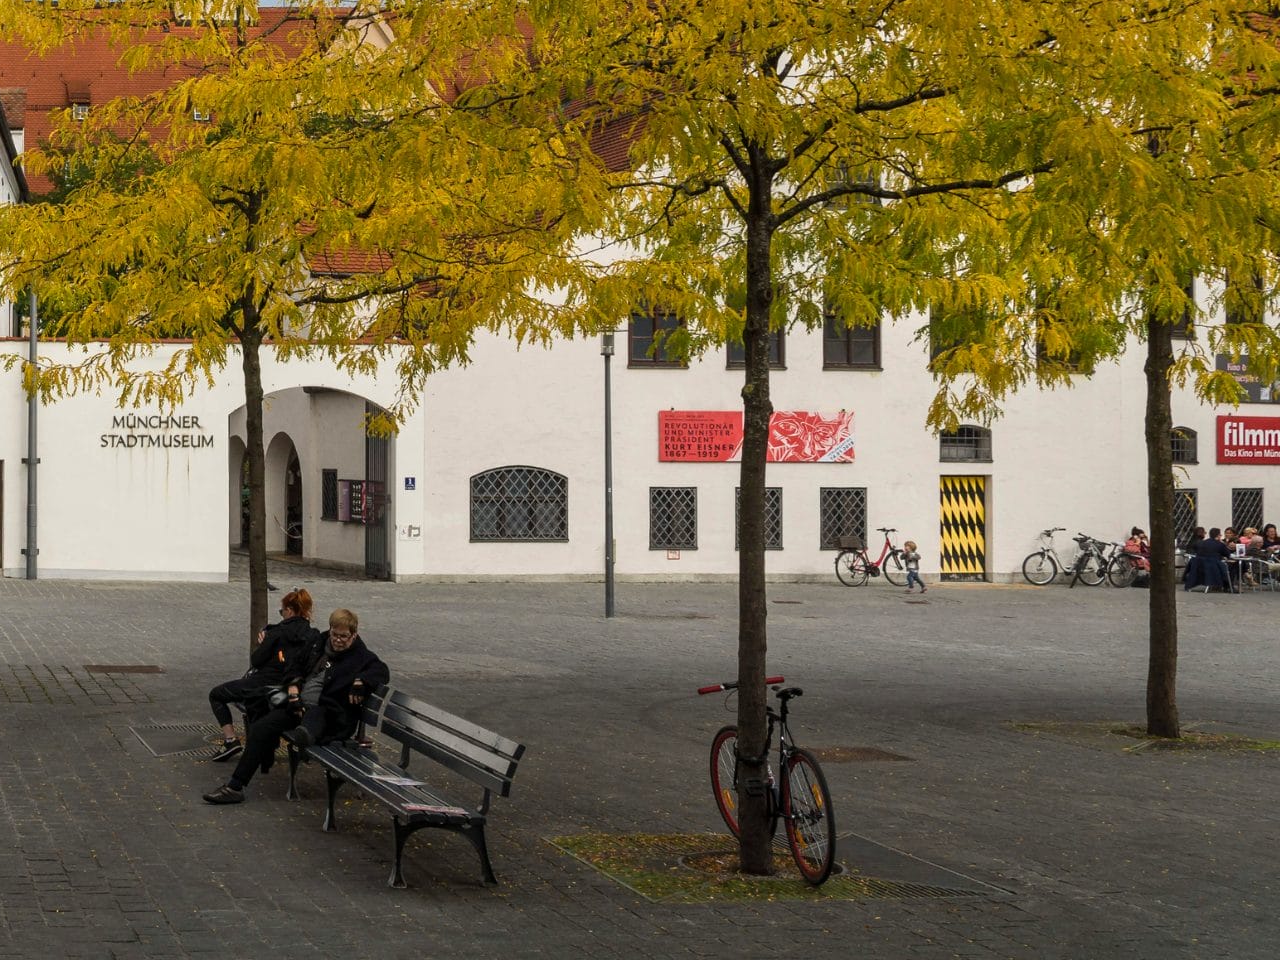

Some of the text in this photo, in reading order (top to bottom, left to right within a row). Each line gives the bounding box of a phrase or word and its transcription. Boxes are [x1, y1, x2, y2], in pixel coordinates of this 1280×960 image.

[112, 413, 201, 429] MÜNCHNER
[100, 434, 214, 448] STADTMUSEUM
[664, 443, 735, 451] KURT EISNER
[1224, 448, 1237, 457] Das
[1237, 448, 1253, 457] Kino
[1254, 448, 1263, 457] im
